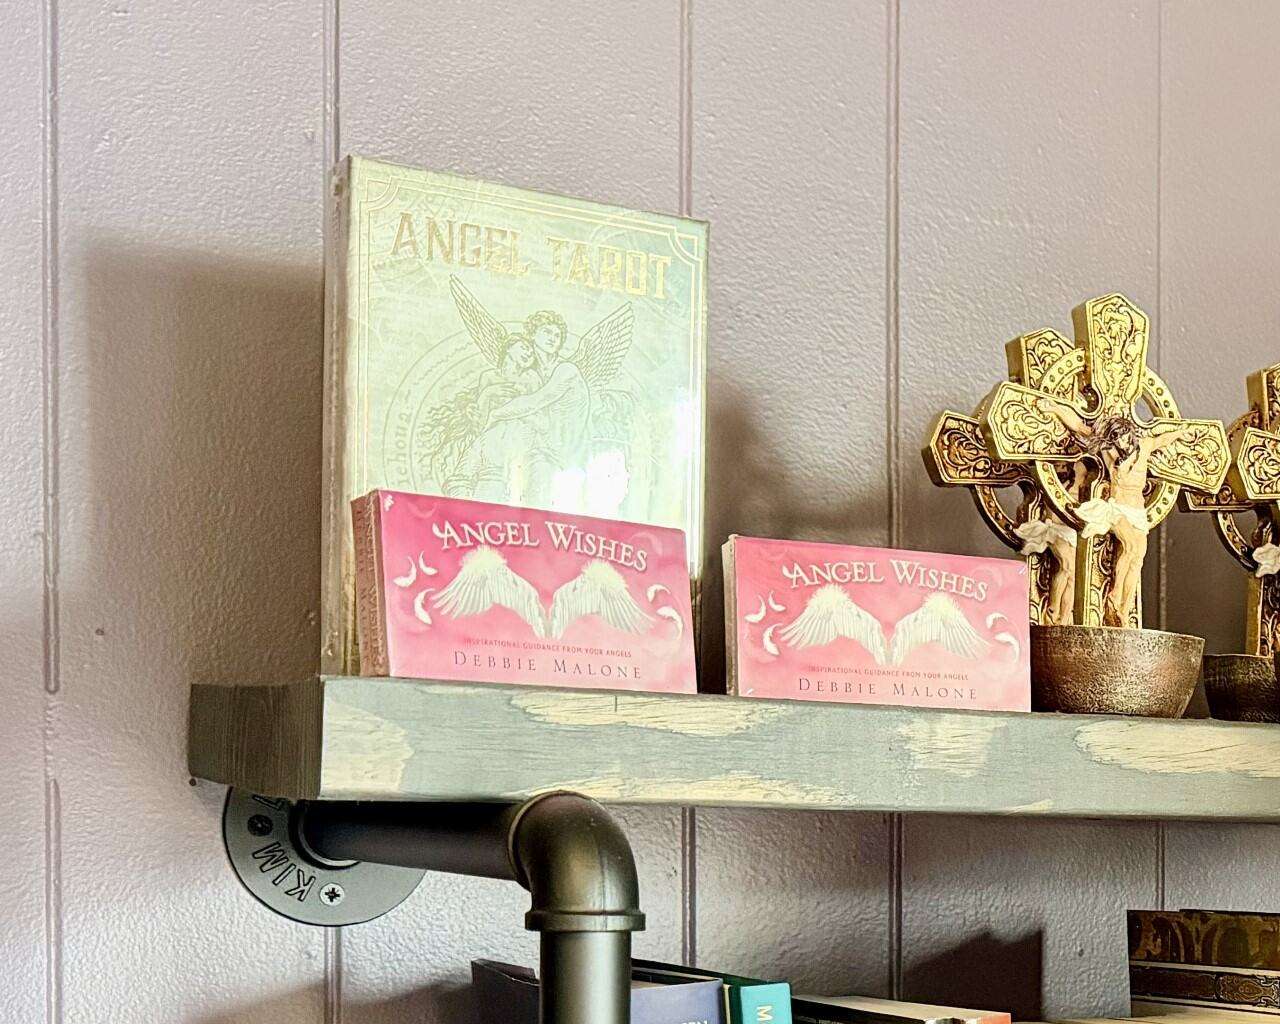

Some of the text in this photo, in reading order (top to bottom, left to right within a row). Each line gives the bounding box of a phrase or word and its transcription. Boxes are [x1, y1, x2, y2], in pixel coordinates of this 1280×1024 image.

[390, 212, 674, 302] ANGEL TAROT
[433, 521, 648, 572] ANGEL WISHES
[782, 559, 988, 601] ANGEL WISHES
[454, 651, 642, 679] DEBBIE MALONE
[523, 642, 560, 652] GUIDANCE
[563, 645, 582, 653] FROM
[585, 648, 603, 656] YOUR
[606, 649, 632, 658] ANGELS
